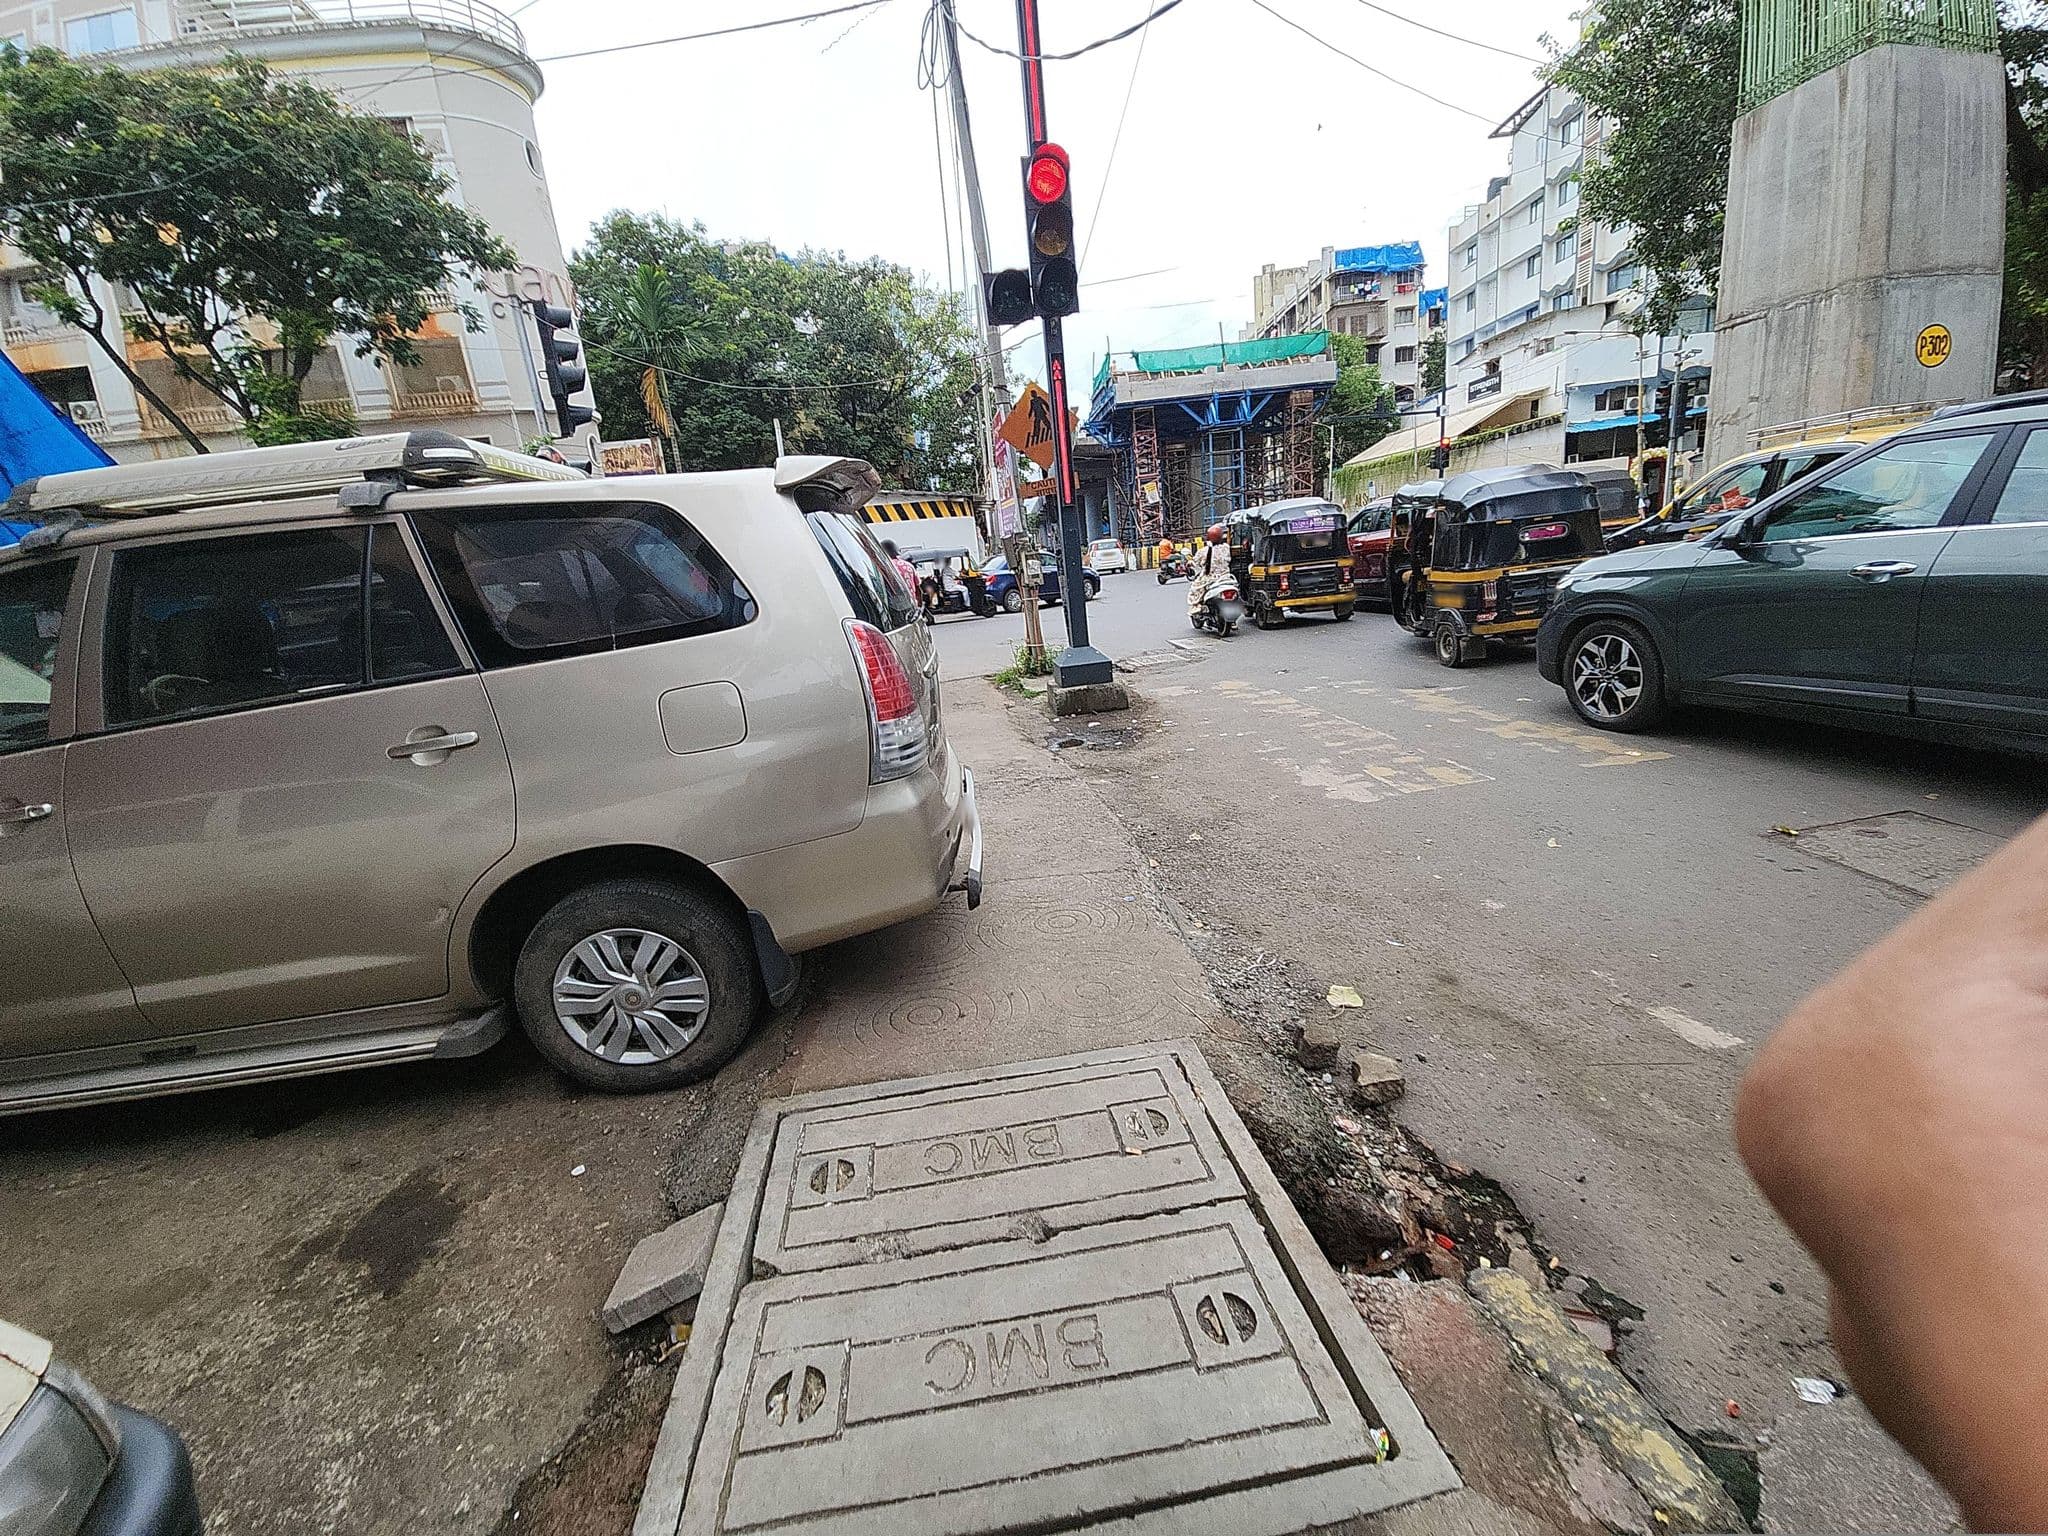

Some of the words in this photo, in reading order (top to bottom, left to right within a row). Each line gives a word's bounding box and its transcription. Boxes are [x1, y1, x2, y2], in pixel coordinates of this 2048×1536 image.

[1919, 335, 1948, 357] P-302
[1470, 376, 1500, 393] STRENGTH
[924, 1124, 1064, 1175] BMC
[924, 1313, 1109, 1395] BMC
